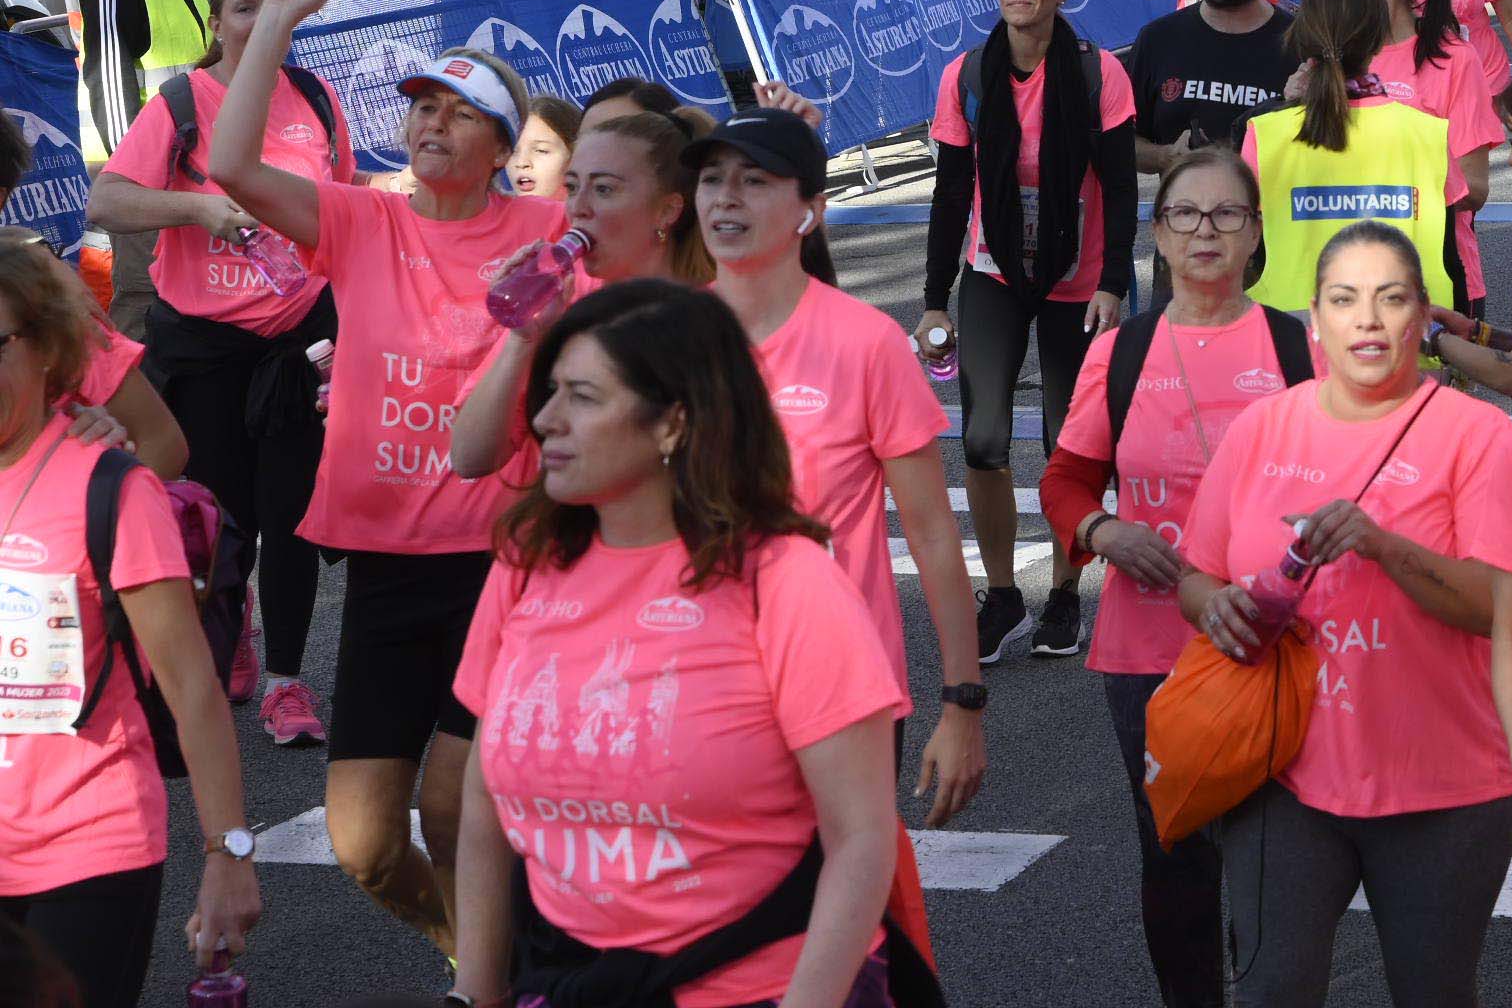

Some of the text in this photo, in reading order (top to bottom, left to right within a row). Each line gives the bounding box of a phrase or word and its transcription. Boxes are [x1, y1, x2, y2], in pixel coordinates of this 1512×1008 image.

[660, 39, 720, 81] ASTUR
[1293, 193, 1410, 212] VOLUNTARIS
[207, 262, 267, 289] SUM
[382, 352, 424, 388] TU
[380, 396, 455, 433] DOR
[374, 441, 452, 476] SUM
[1126, 477, 1168, 508] TU
[533, 796, 683, 830] DORSAL
